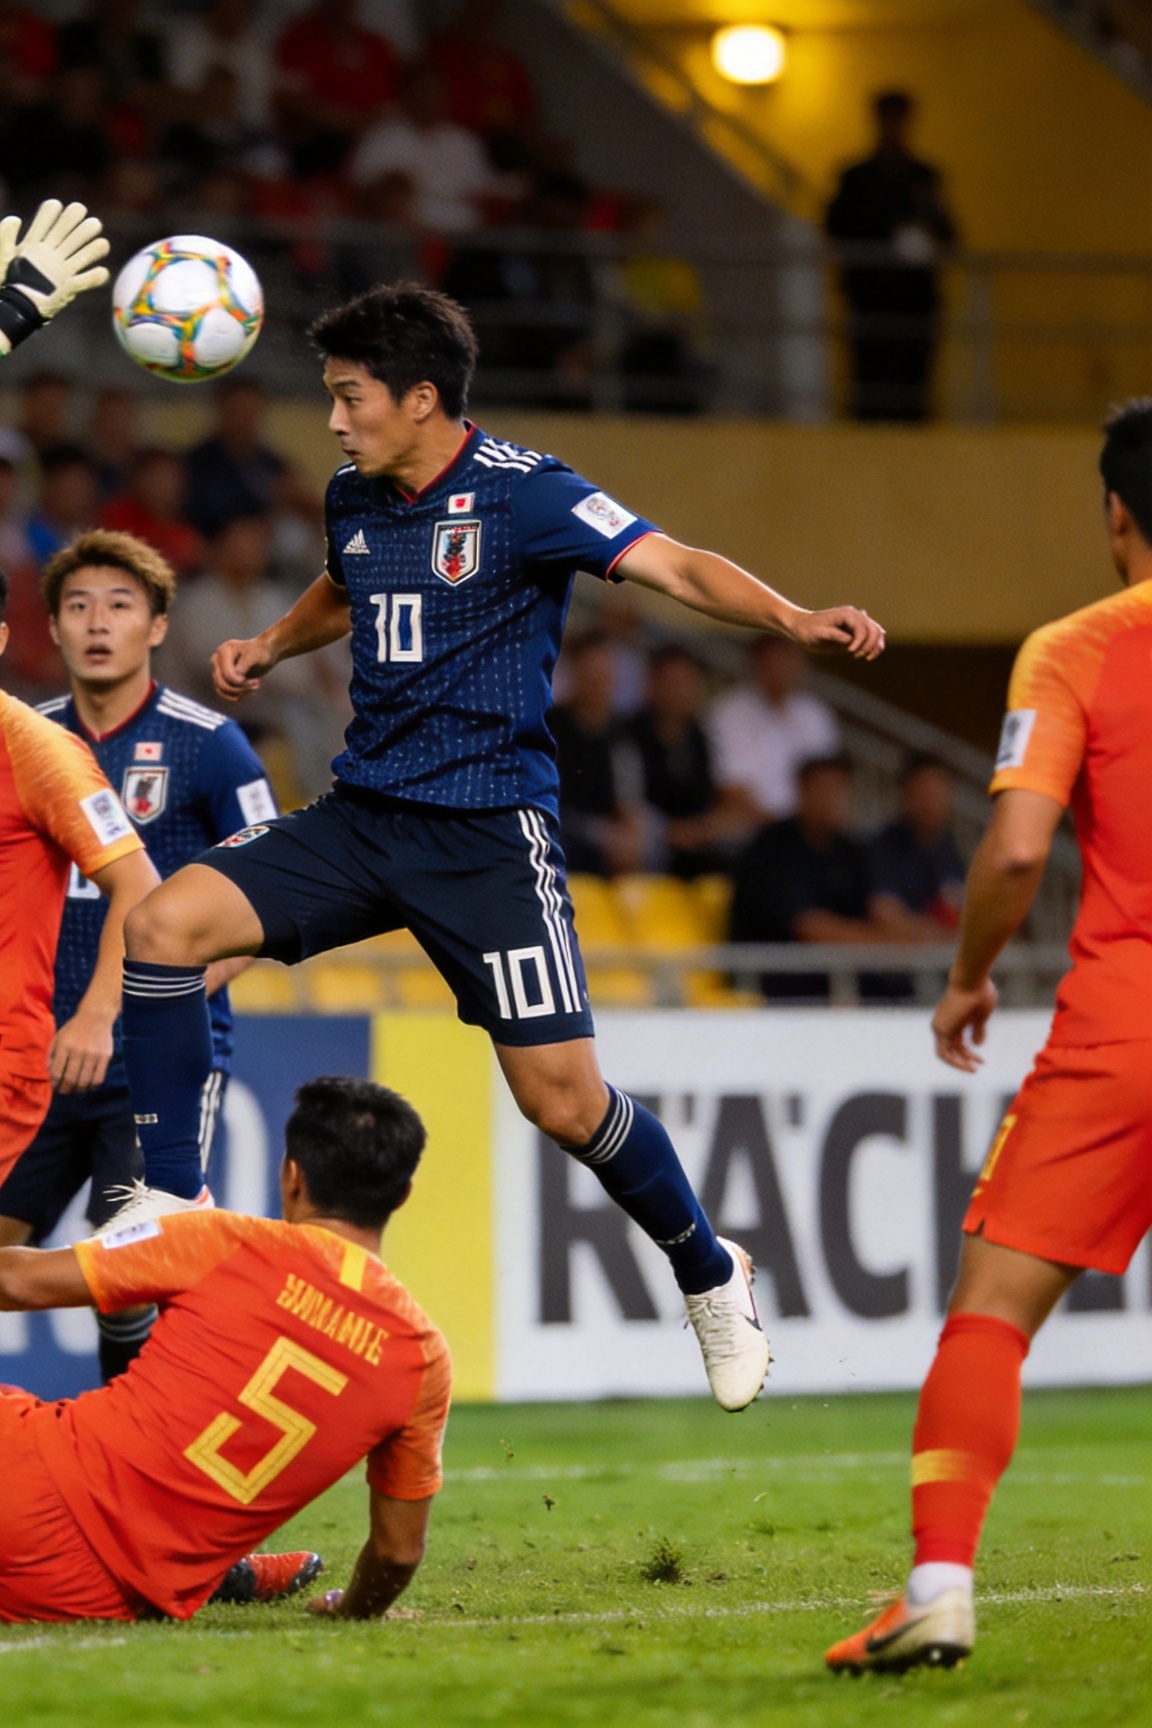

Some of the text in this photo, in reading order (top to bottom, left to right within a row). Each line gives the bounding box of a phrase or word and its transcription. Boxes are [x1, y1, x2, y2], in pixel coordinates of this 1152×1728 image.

[369, 593, 424, 664] 10
[482, 945, 556, 1020] 10
[183, 1336, 350, 1506] 5
